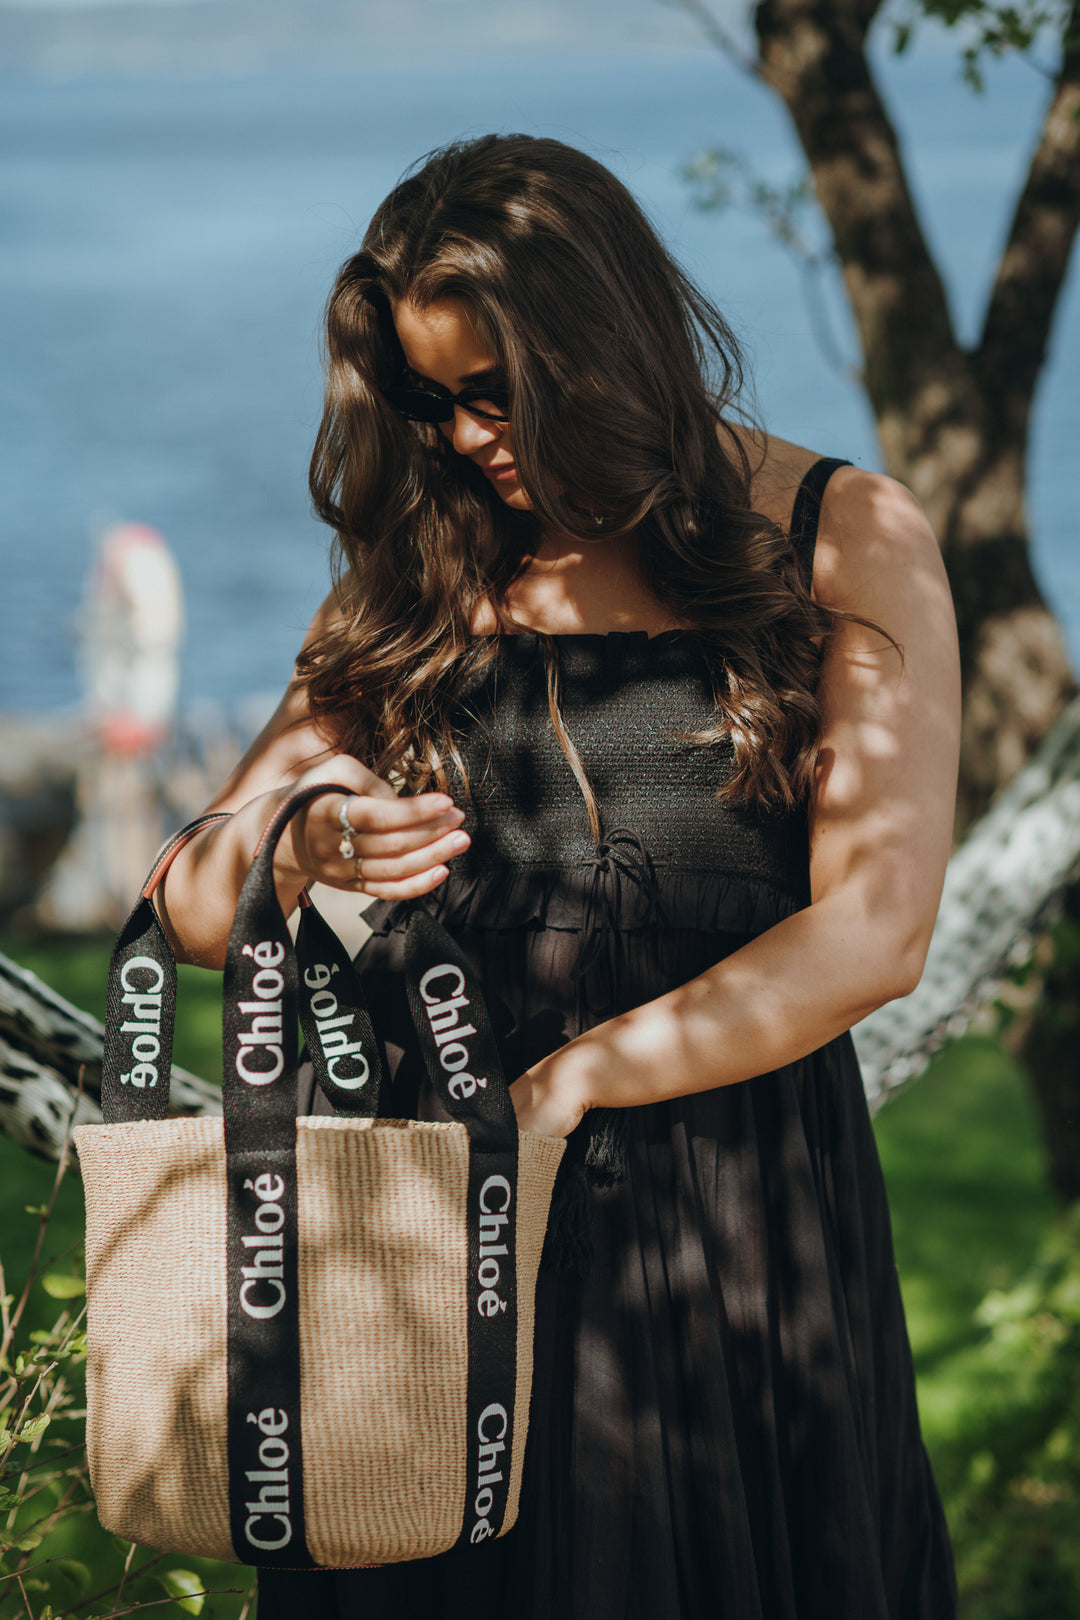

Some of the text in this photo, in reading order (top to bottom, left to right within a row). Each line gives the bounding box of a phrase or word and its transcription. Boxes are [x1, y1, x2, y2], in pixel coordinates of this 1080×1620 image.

[235, 940, 285, 1087] Chloé
[419, 963, 488, 1100] Chloé
[239, 1172, 286, 1320] Chloé
[477, 1174, 511, 1317] Chloé
[244, 1407, 293, 1550] Chloé
